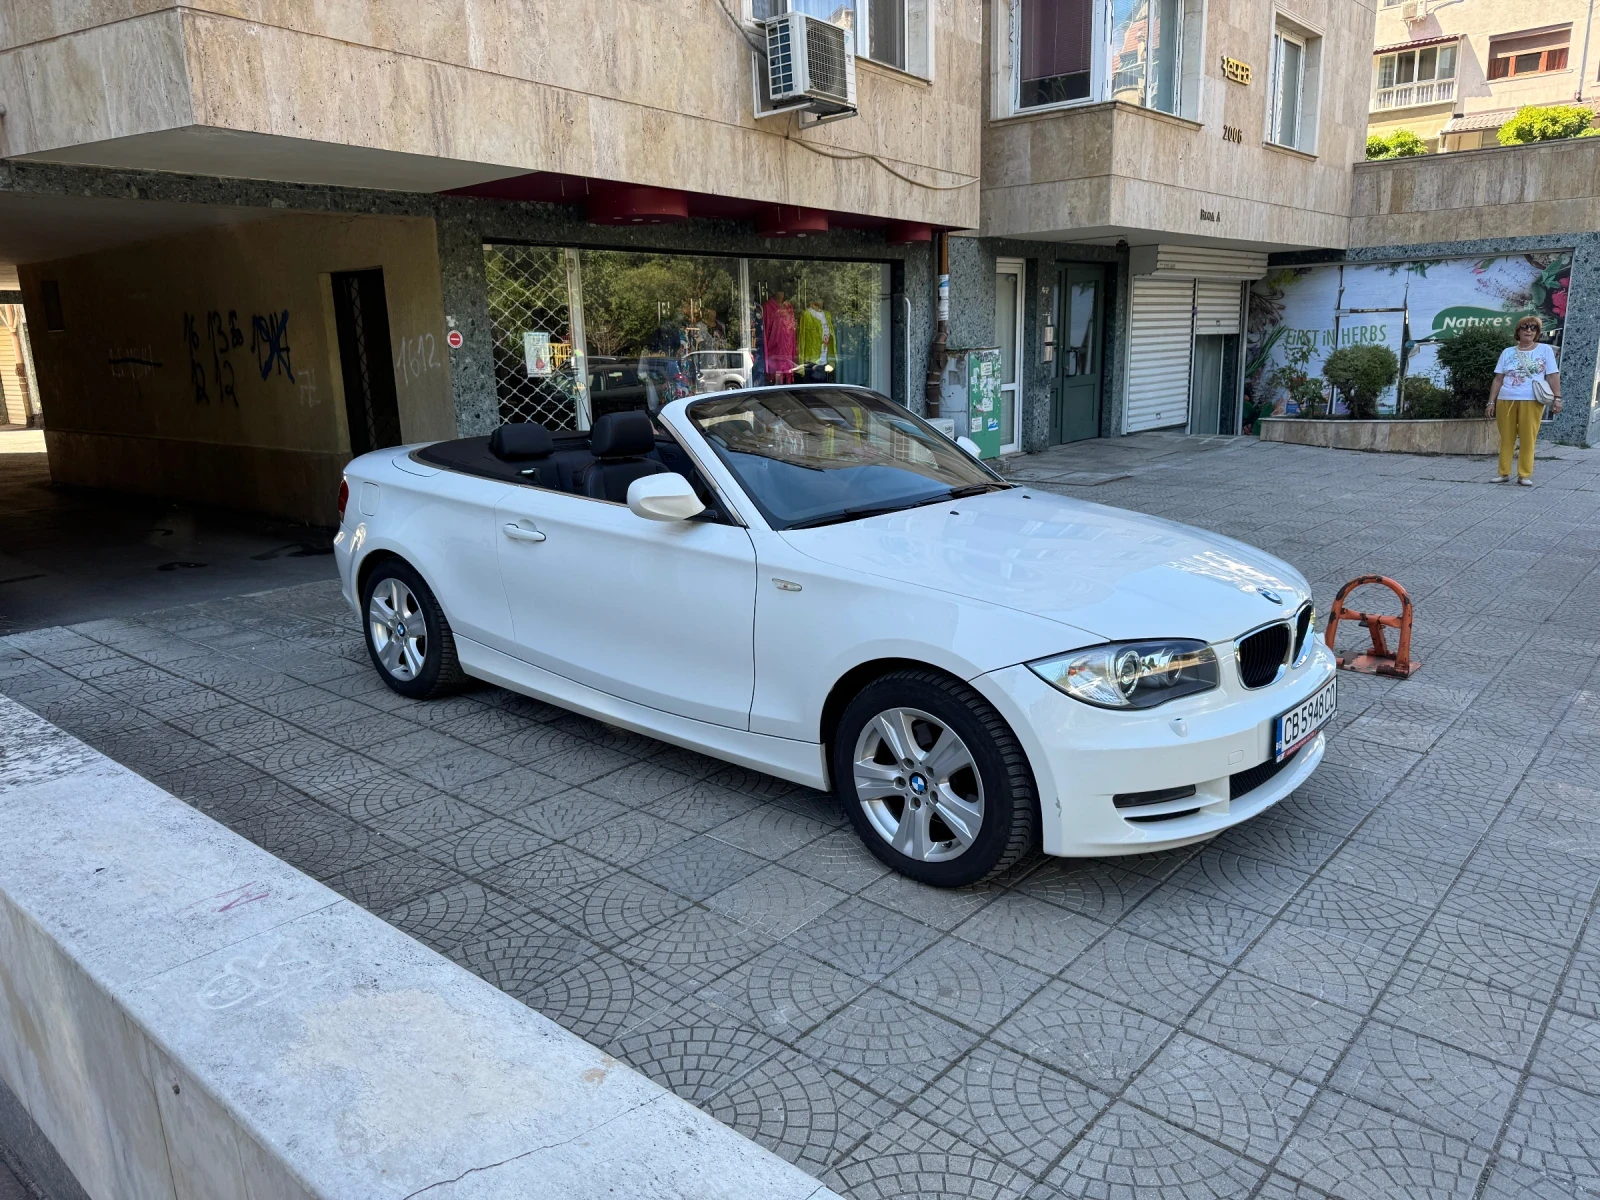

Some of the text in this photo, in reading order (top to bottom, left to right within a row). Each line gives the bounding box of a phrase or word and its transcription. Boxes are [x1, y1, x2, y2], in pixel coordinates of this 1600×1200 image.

[1223, 124, 1242, 144] 2006
[1443, 315, 1512, 330] Nature's
[1341, 324, 1387, 345] HERBS
[397, 332, 441, 387] 1612
[1284, 712, 1299, 744] CB
[1301, 694, 1324, 733] 5948
